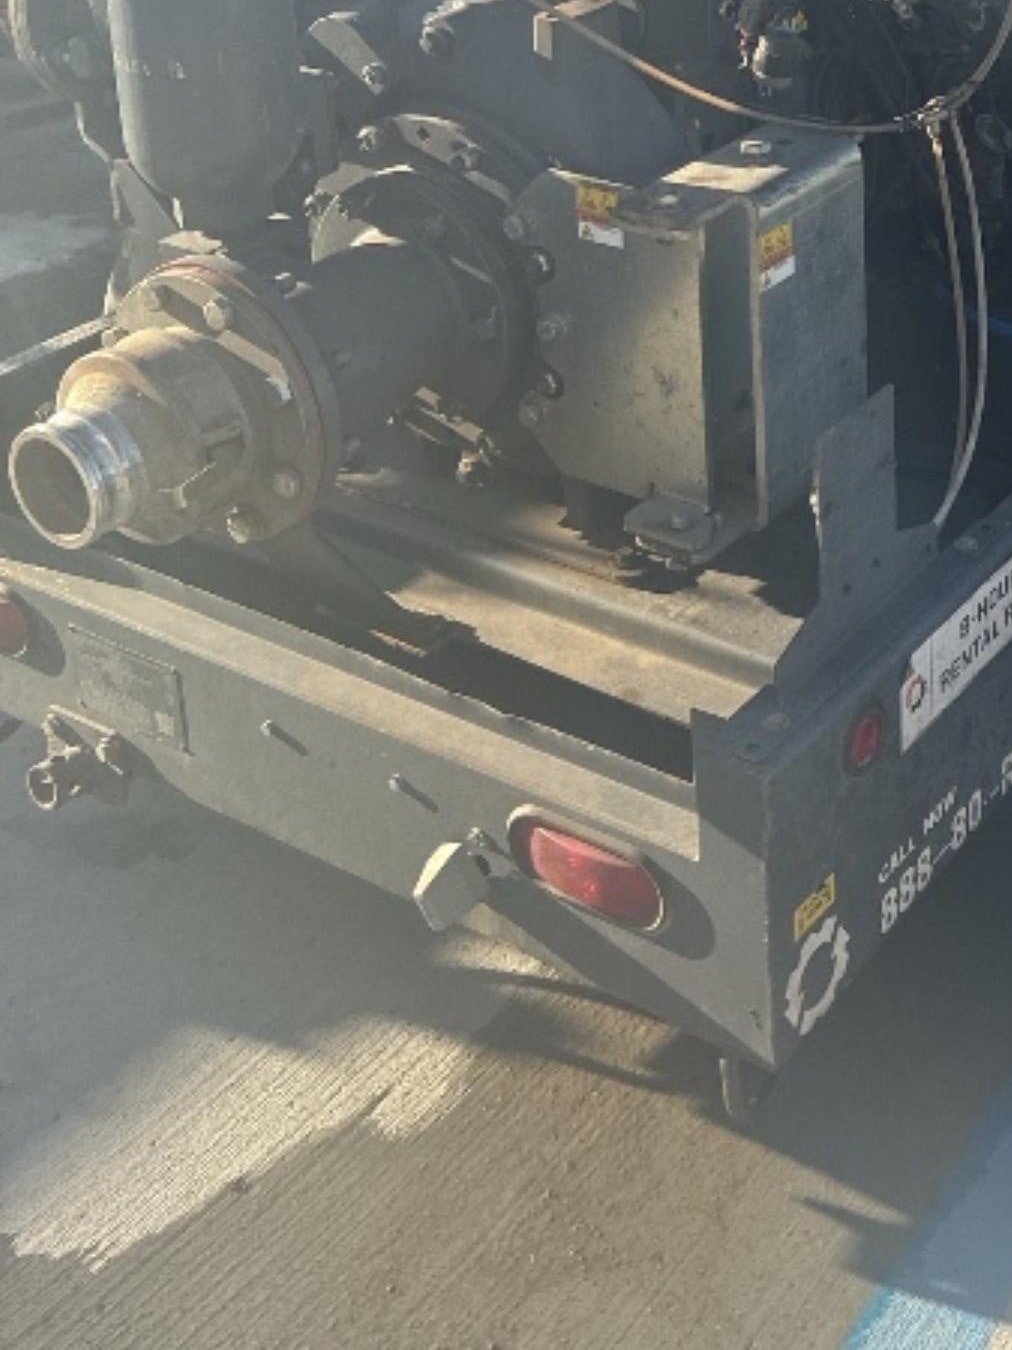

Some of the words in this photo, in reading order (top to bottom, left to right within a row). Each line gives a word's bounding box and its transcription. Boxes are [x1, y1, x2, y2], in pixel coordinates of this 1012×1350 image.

[939, 620, 999, 693] RENTAL
[878, 837, 916, 884] CALL
[922, 785, 958, 835] NOW
